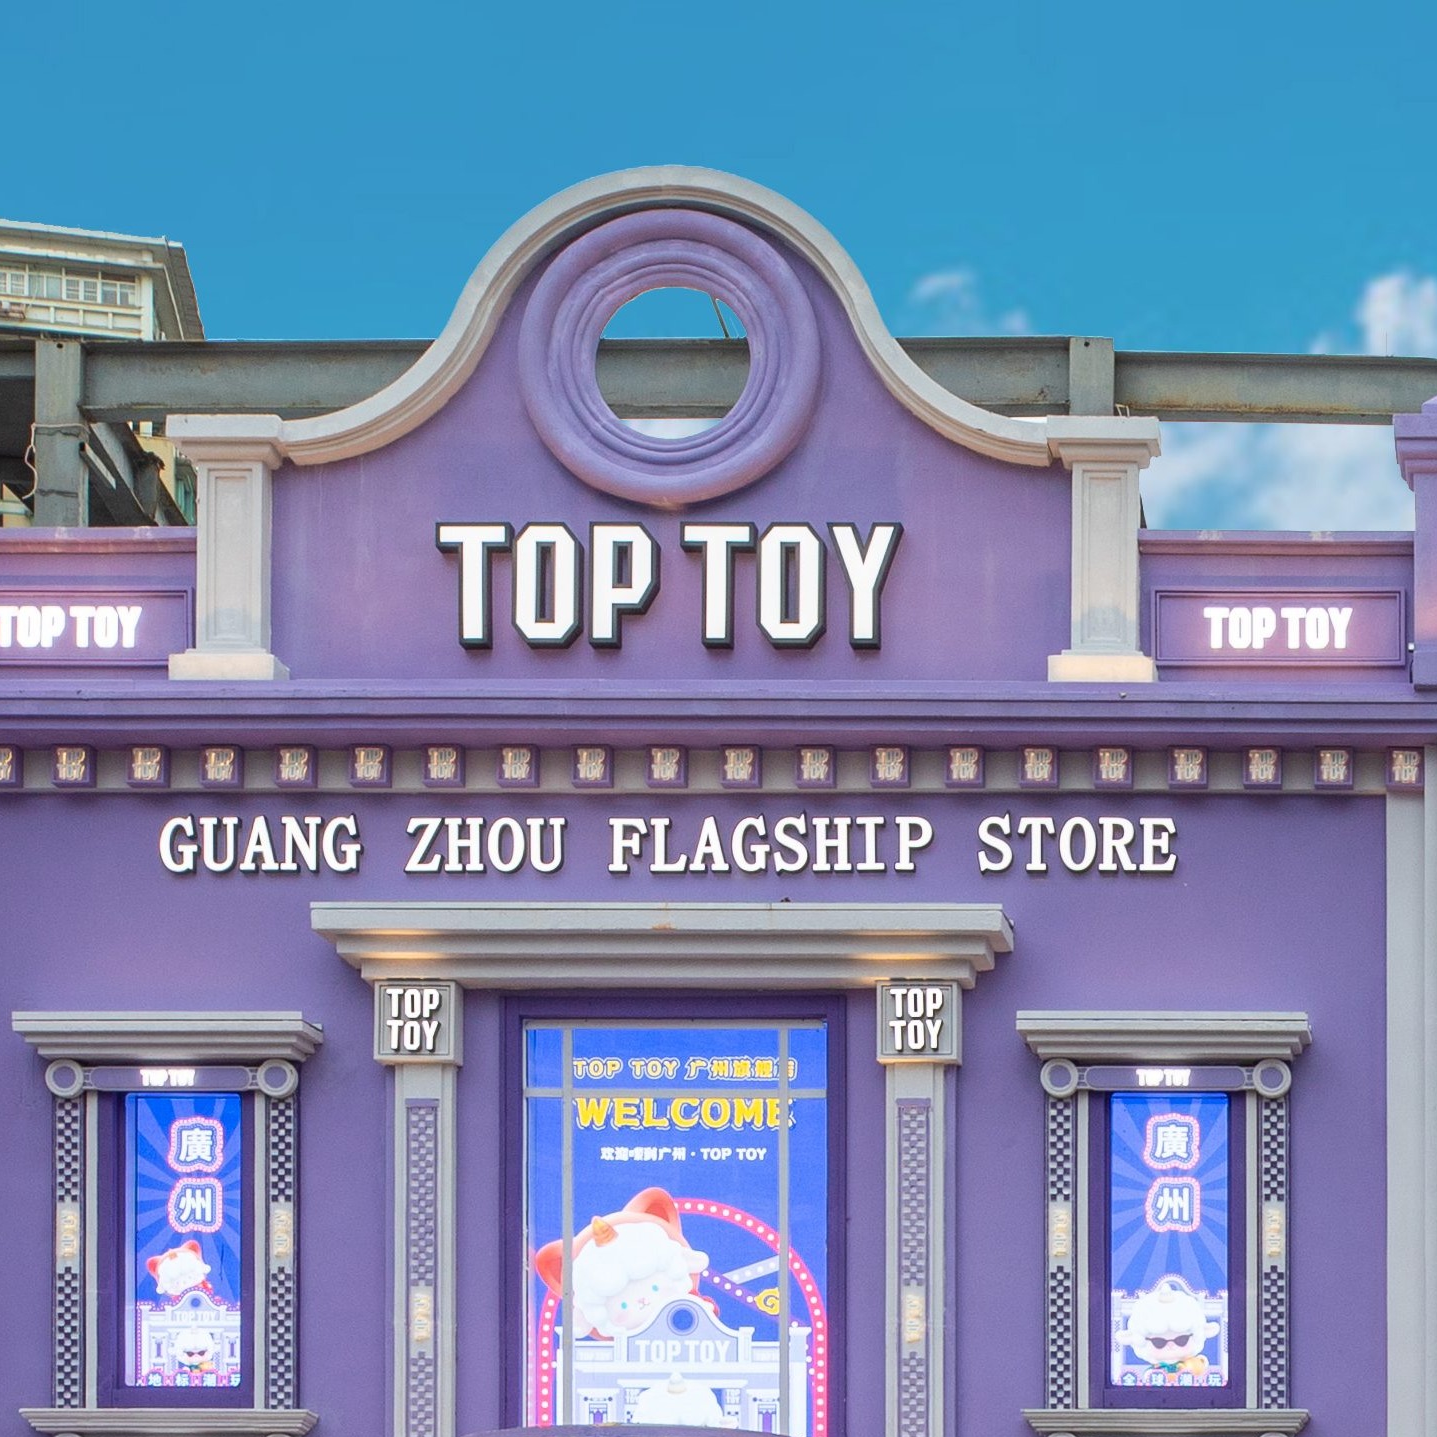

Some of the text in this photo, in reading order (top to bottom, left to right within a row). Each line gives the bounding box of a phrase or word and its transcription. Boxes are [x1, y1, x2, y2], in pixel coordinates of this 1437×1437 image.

[437, 521, 904, 649] TOP TOY
[72, 603, 143, 650] TOY
[1203, 603, 1353, 650] TOP TOY
[158, 812, 1179, 876] GUANG ZHOU FLAGSHIP STORE
[386, 988, 440, 1019] TOP
[890, 987, 944, 1019] TOP
[386, 1019, 440, 1052] TOY
[890, 1019, 944, 1052] TOY
[573, 1058, 622, 1080] TOP
[630, 1058, 679, 1080] TOY
[574, 1097, 793, 1130] WELCOME
[700, 1148, 731, 1160] TOP
[737, 1148, 767, 1160] TOY
[178, 1127, 213, 1223] 廣州
[1154, 1126, 1190, 1222] 廣州
[635, 1340, 731, 1363] TOP TOY
